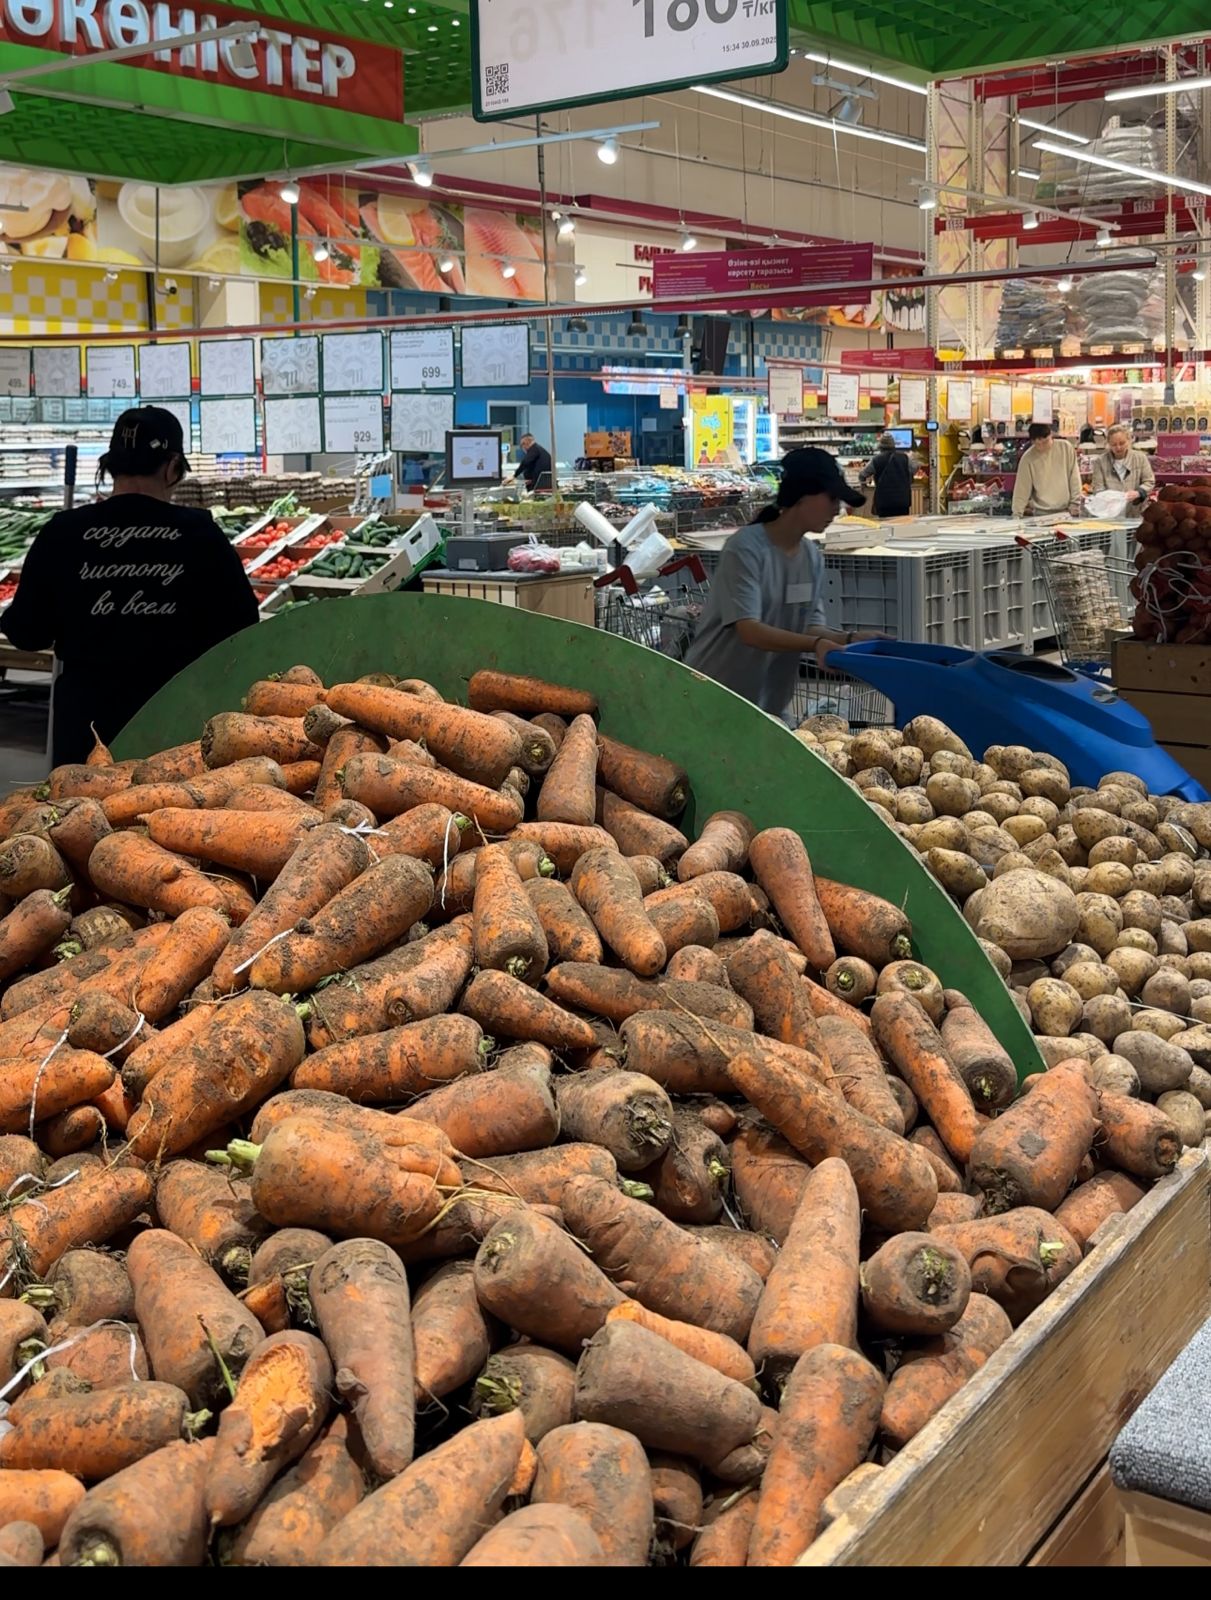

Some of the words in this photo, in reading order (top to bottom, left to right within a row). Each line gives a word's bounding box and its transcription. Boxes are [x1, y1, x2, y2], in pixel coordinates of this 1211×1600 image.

[0, 0, 356, 98] ӨКӨНІСТЕР
[722, 43, 740, 53] 15:34
[422, 366, 441, 378] 699
[111, 378, 127, 389] 749
[353, 430, 371, 442] 929
[90, 590, 116, 615] во
[120, 590, 177, 615] всем
